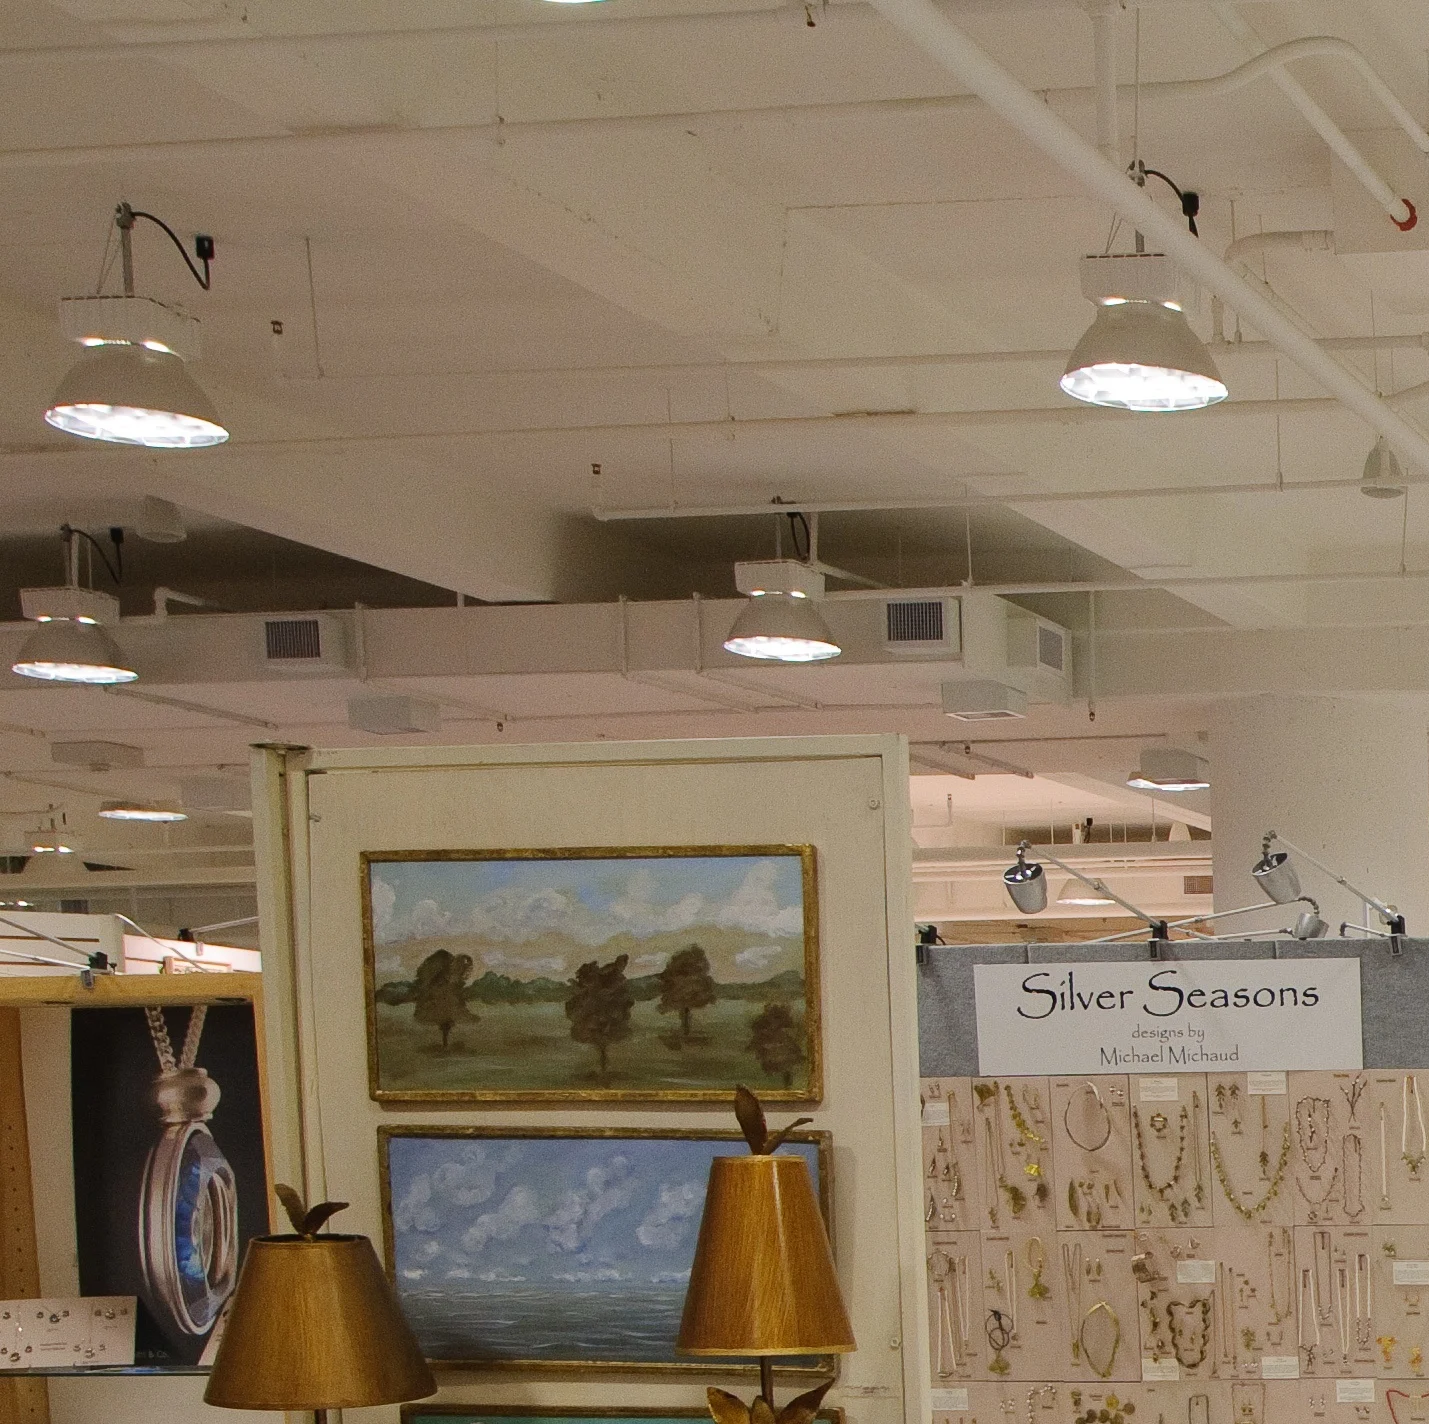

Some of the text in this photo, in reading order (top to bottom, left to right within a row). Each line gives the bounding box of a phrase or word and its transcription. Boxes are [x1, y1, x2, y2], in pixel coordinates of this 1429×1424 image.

[1016, 970, 1321, 1020] Silver Seasons
[1131, 1022, 1206, 1044] designs by
[1099, 1043, 1240, 1067] Michael Michaud
